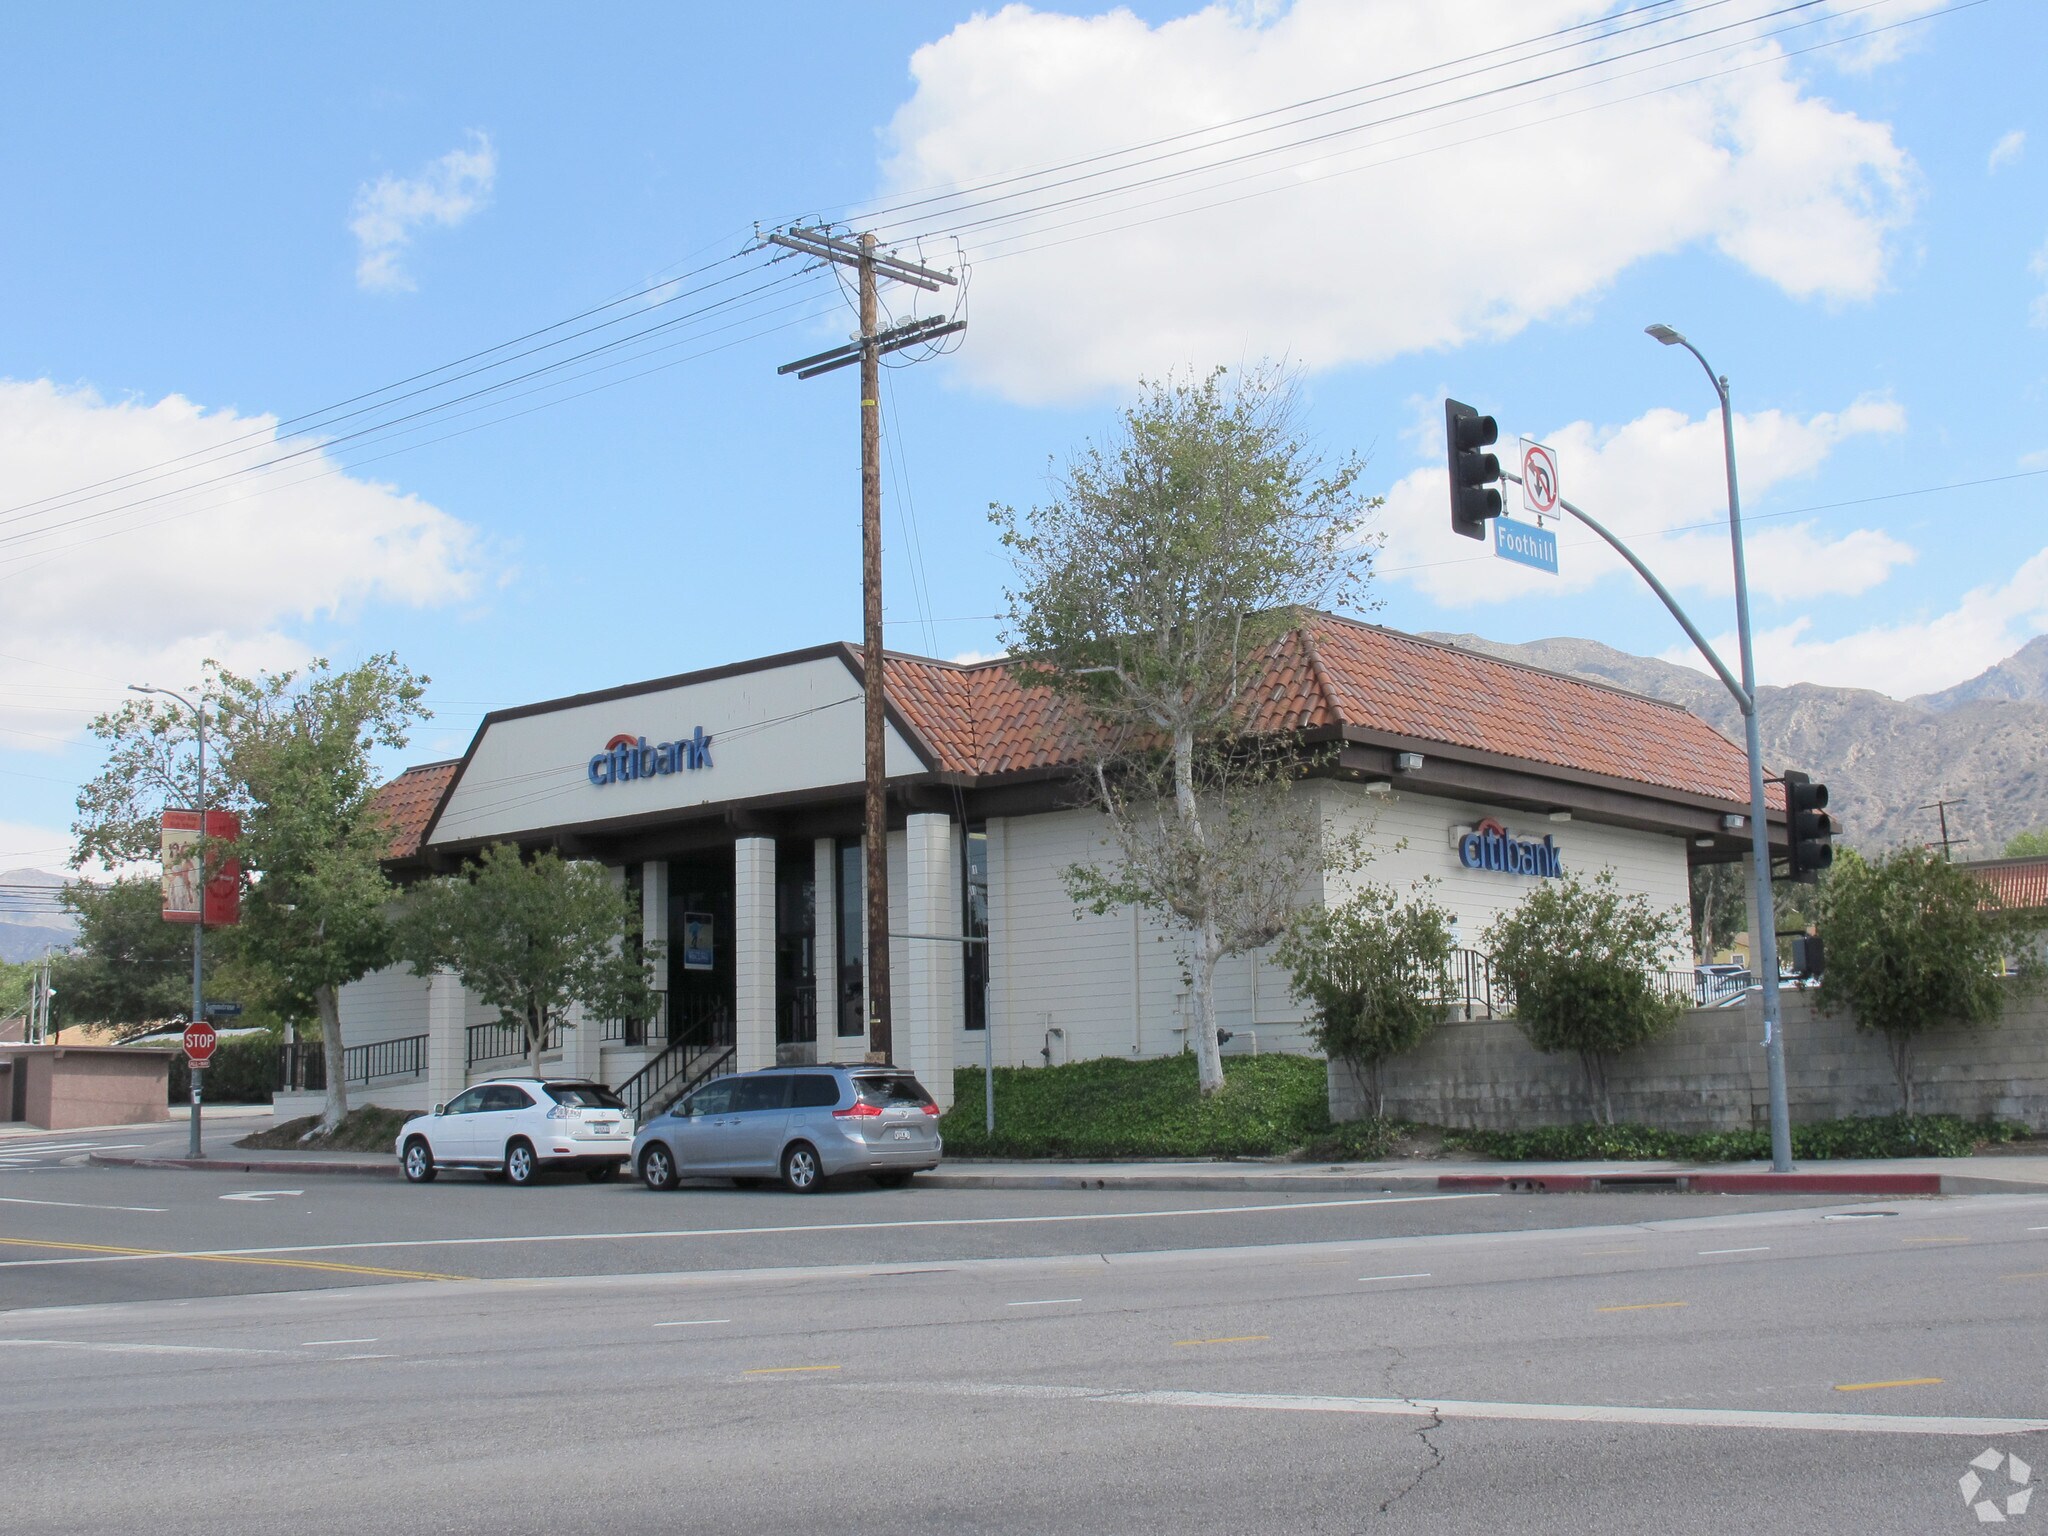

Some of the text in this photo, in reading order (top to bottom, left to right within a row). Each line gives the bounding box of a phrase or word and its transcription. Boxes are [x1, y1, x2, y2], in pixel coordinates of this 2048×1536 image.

[1498, 526, 1553, 562] Foothill
[588, 726, 713, 785] citibank
[1459, 820, 1562, 878] citibank
[185, 1034, 214, 1048] STOP
